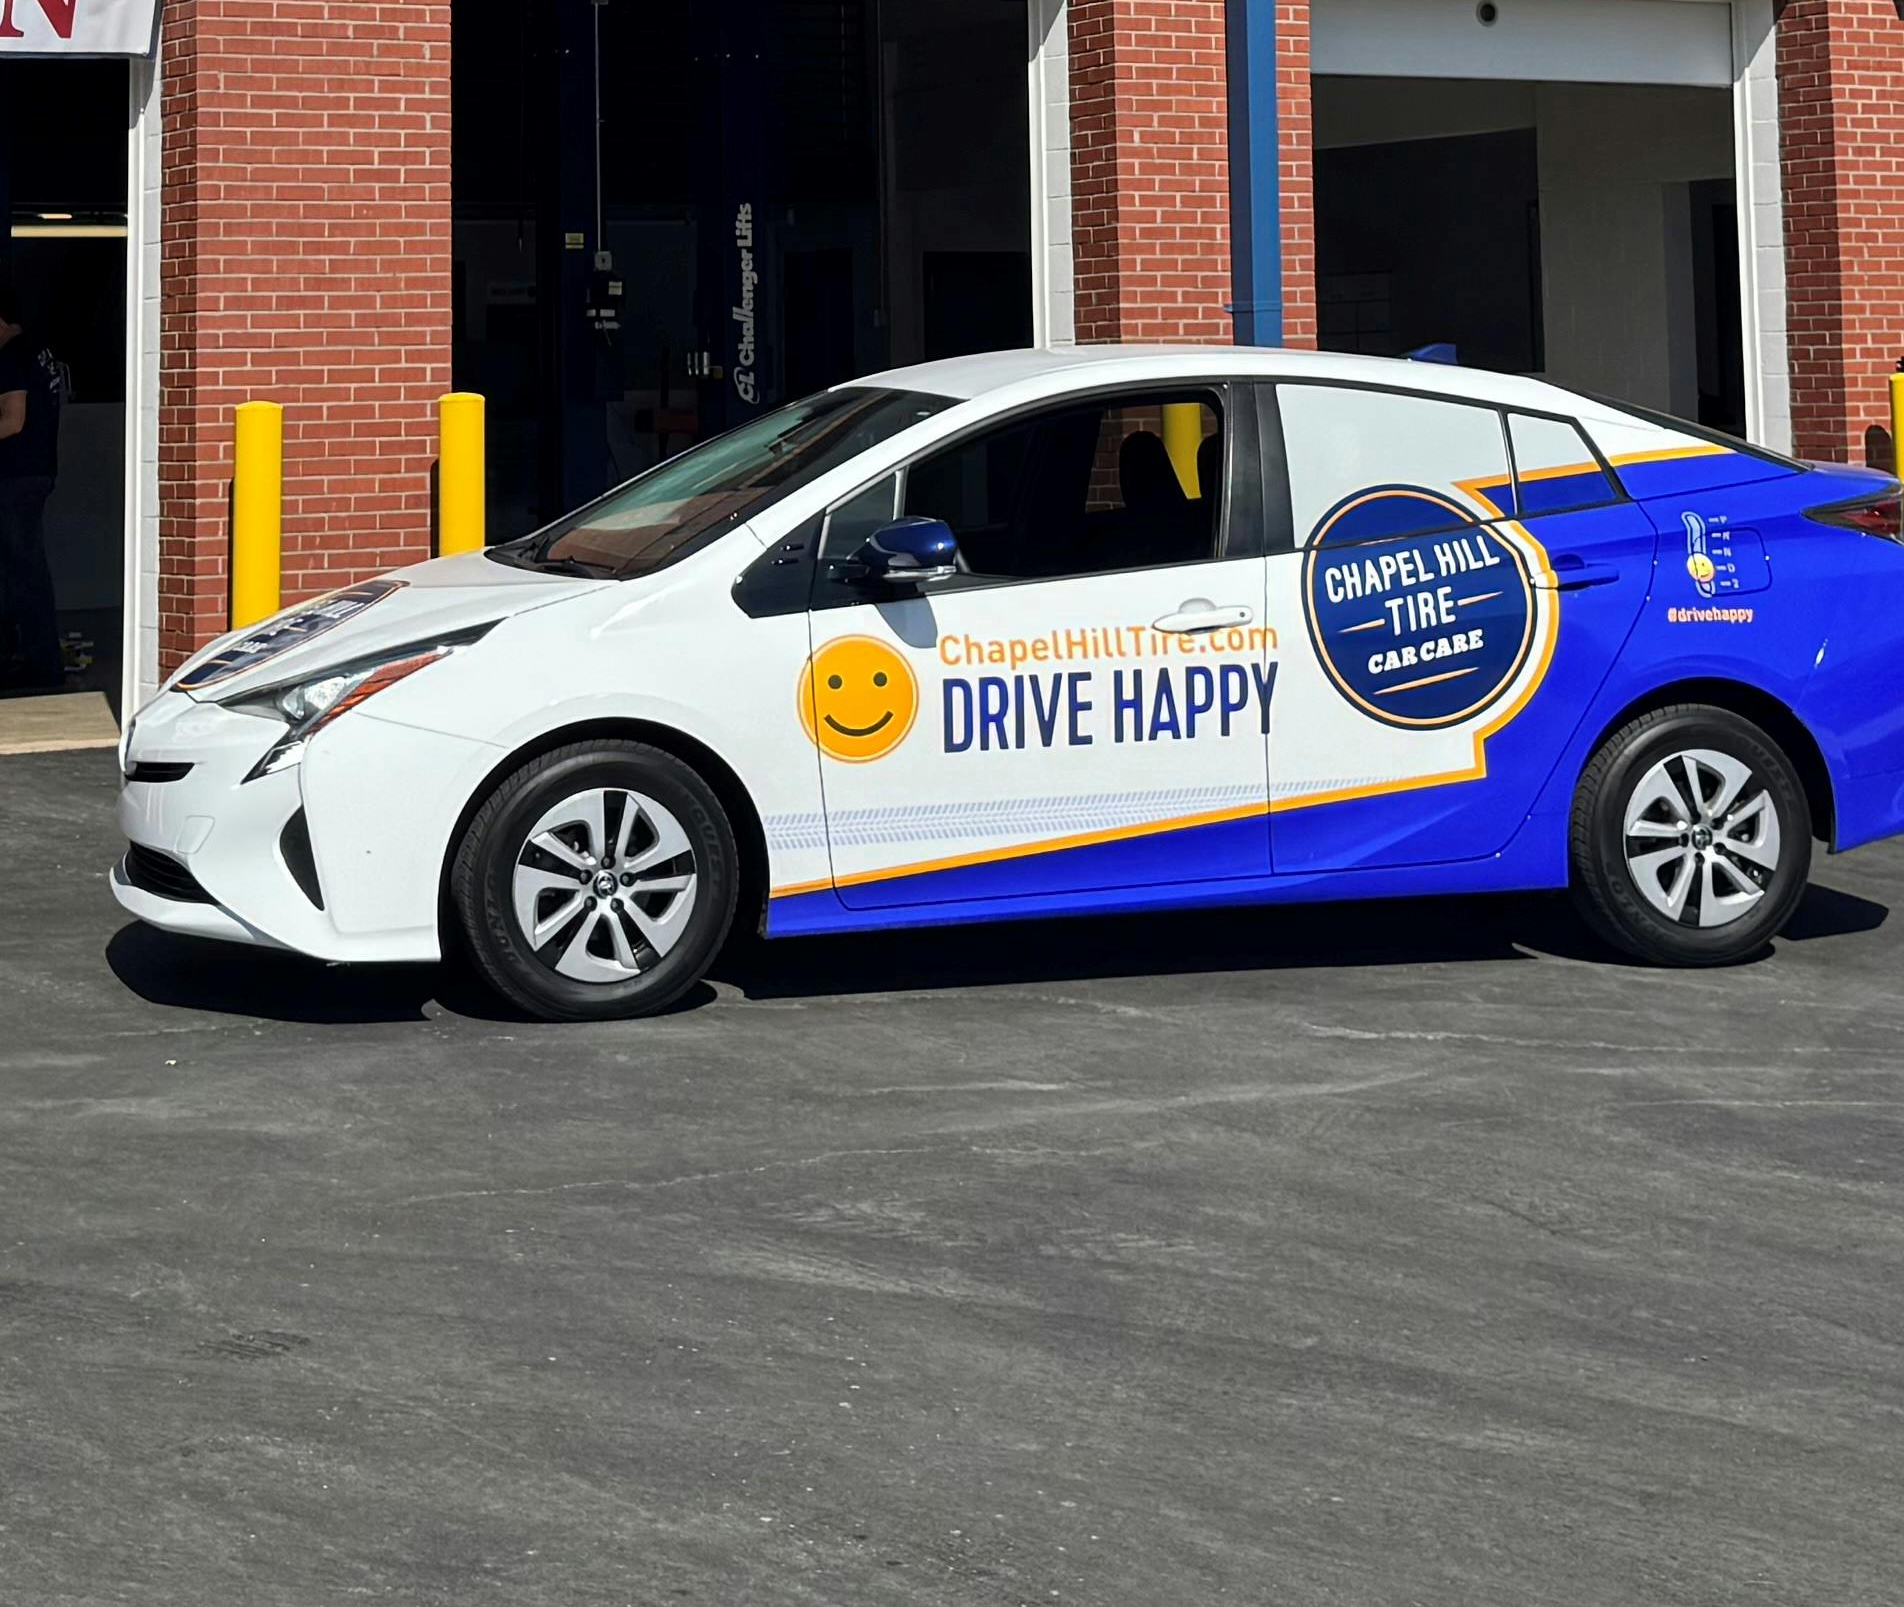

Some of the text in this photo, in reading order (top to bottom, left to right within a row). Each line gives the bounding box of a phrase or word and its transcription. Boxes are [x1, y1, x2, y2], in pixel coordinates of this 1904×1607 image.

[735, 201, 754, 248] Lifts
[732, 247, 760, 366] Challenger
[1324, 535, 1500, 604] CHAPEL HILL
[1384, 586, 1457, 636] TIRE
[939, 626, 1278, 670] ChapelHillTire.com
[1368, 629, 1484, 674] CAR CARE
[942, 661, 1279, 754] DRIVE HAPPY
